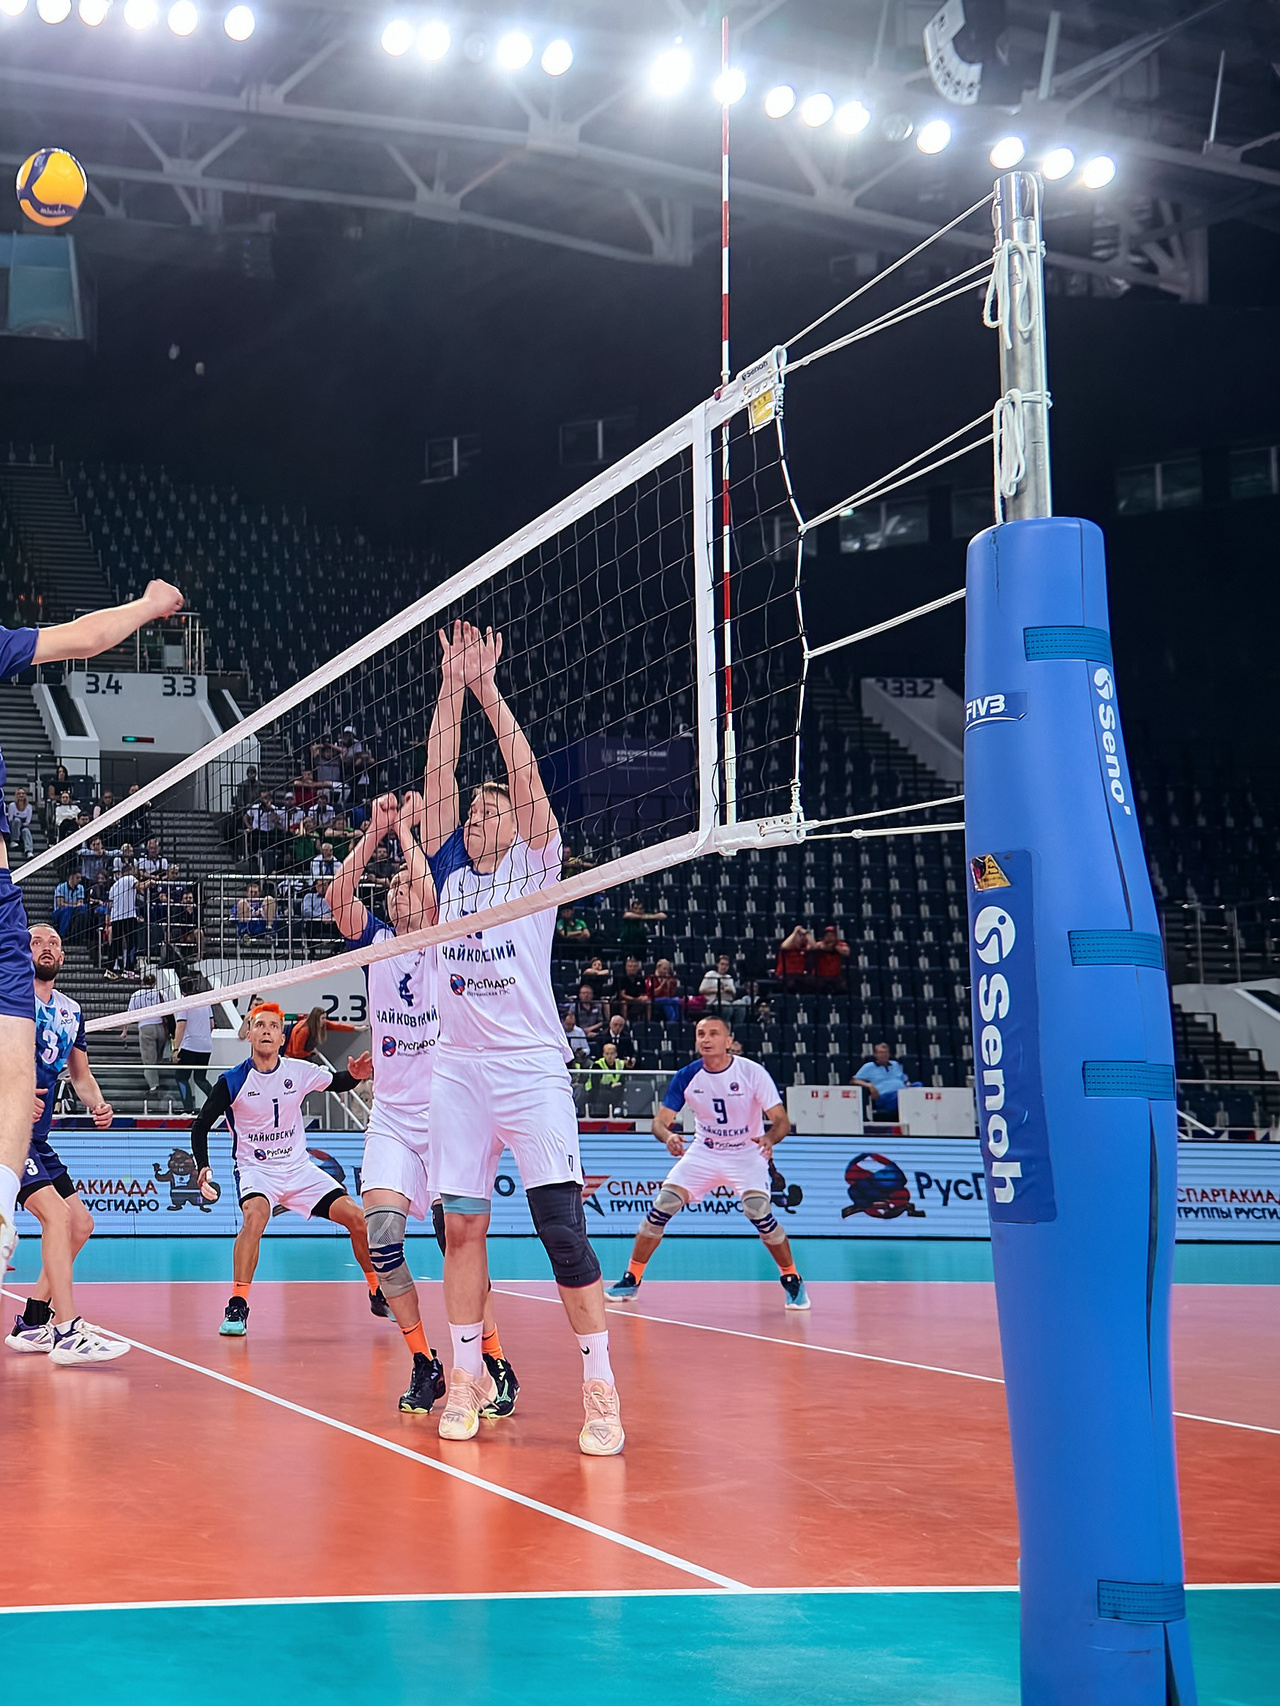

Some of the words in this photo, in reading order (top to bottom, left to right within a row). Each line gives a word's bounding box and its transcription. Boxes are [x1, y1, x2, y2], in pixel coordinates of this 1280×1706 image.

[747, 361, 769, 378] Senoh
[86, 673, 122, 695] 3.4
[162, 676, 196, 697] 3.3
[1098, 703, 1132, 816] Seno
[322, 994, 367, 1022] 2.3
[41, 1030, 59, 1065] 3
[978, 972, 1023, 1204] Senoh
[712, 1098, 728, 1124] 9
[25, 1158, 39, 1176] 3
[75, 1179, 158, 1197] АКИАДА
[915, 1171, 984, 1206] РусГ
[1177, 1187, 1280, 1204] СПАРТАКИА
[83, 1198, 160, 1213] УСГИДРО
[610, 1200, 654, 1212] ГРУПП
[1177, 1206, 1233, 1219] ГРУППЫ
[1234, 1207, 1280, 1220] РУСГИ
